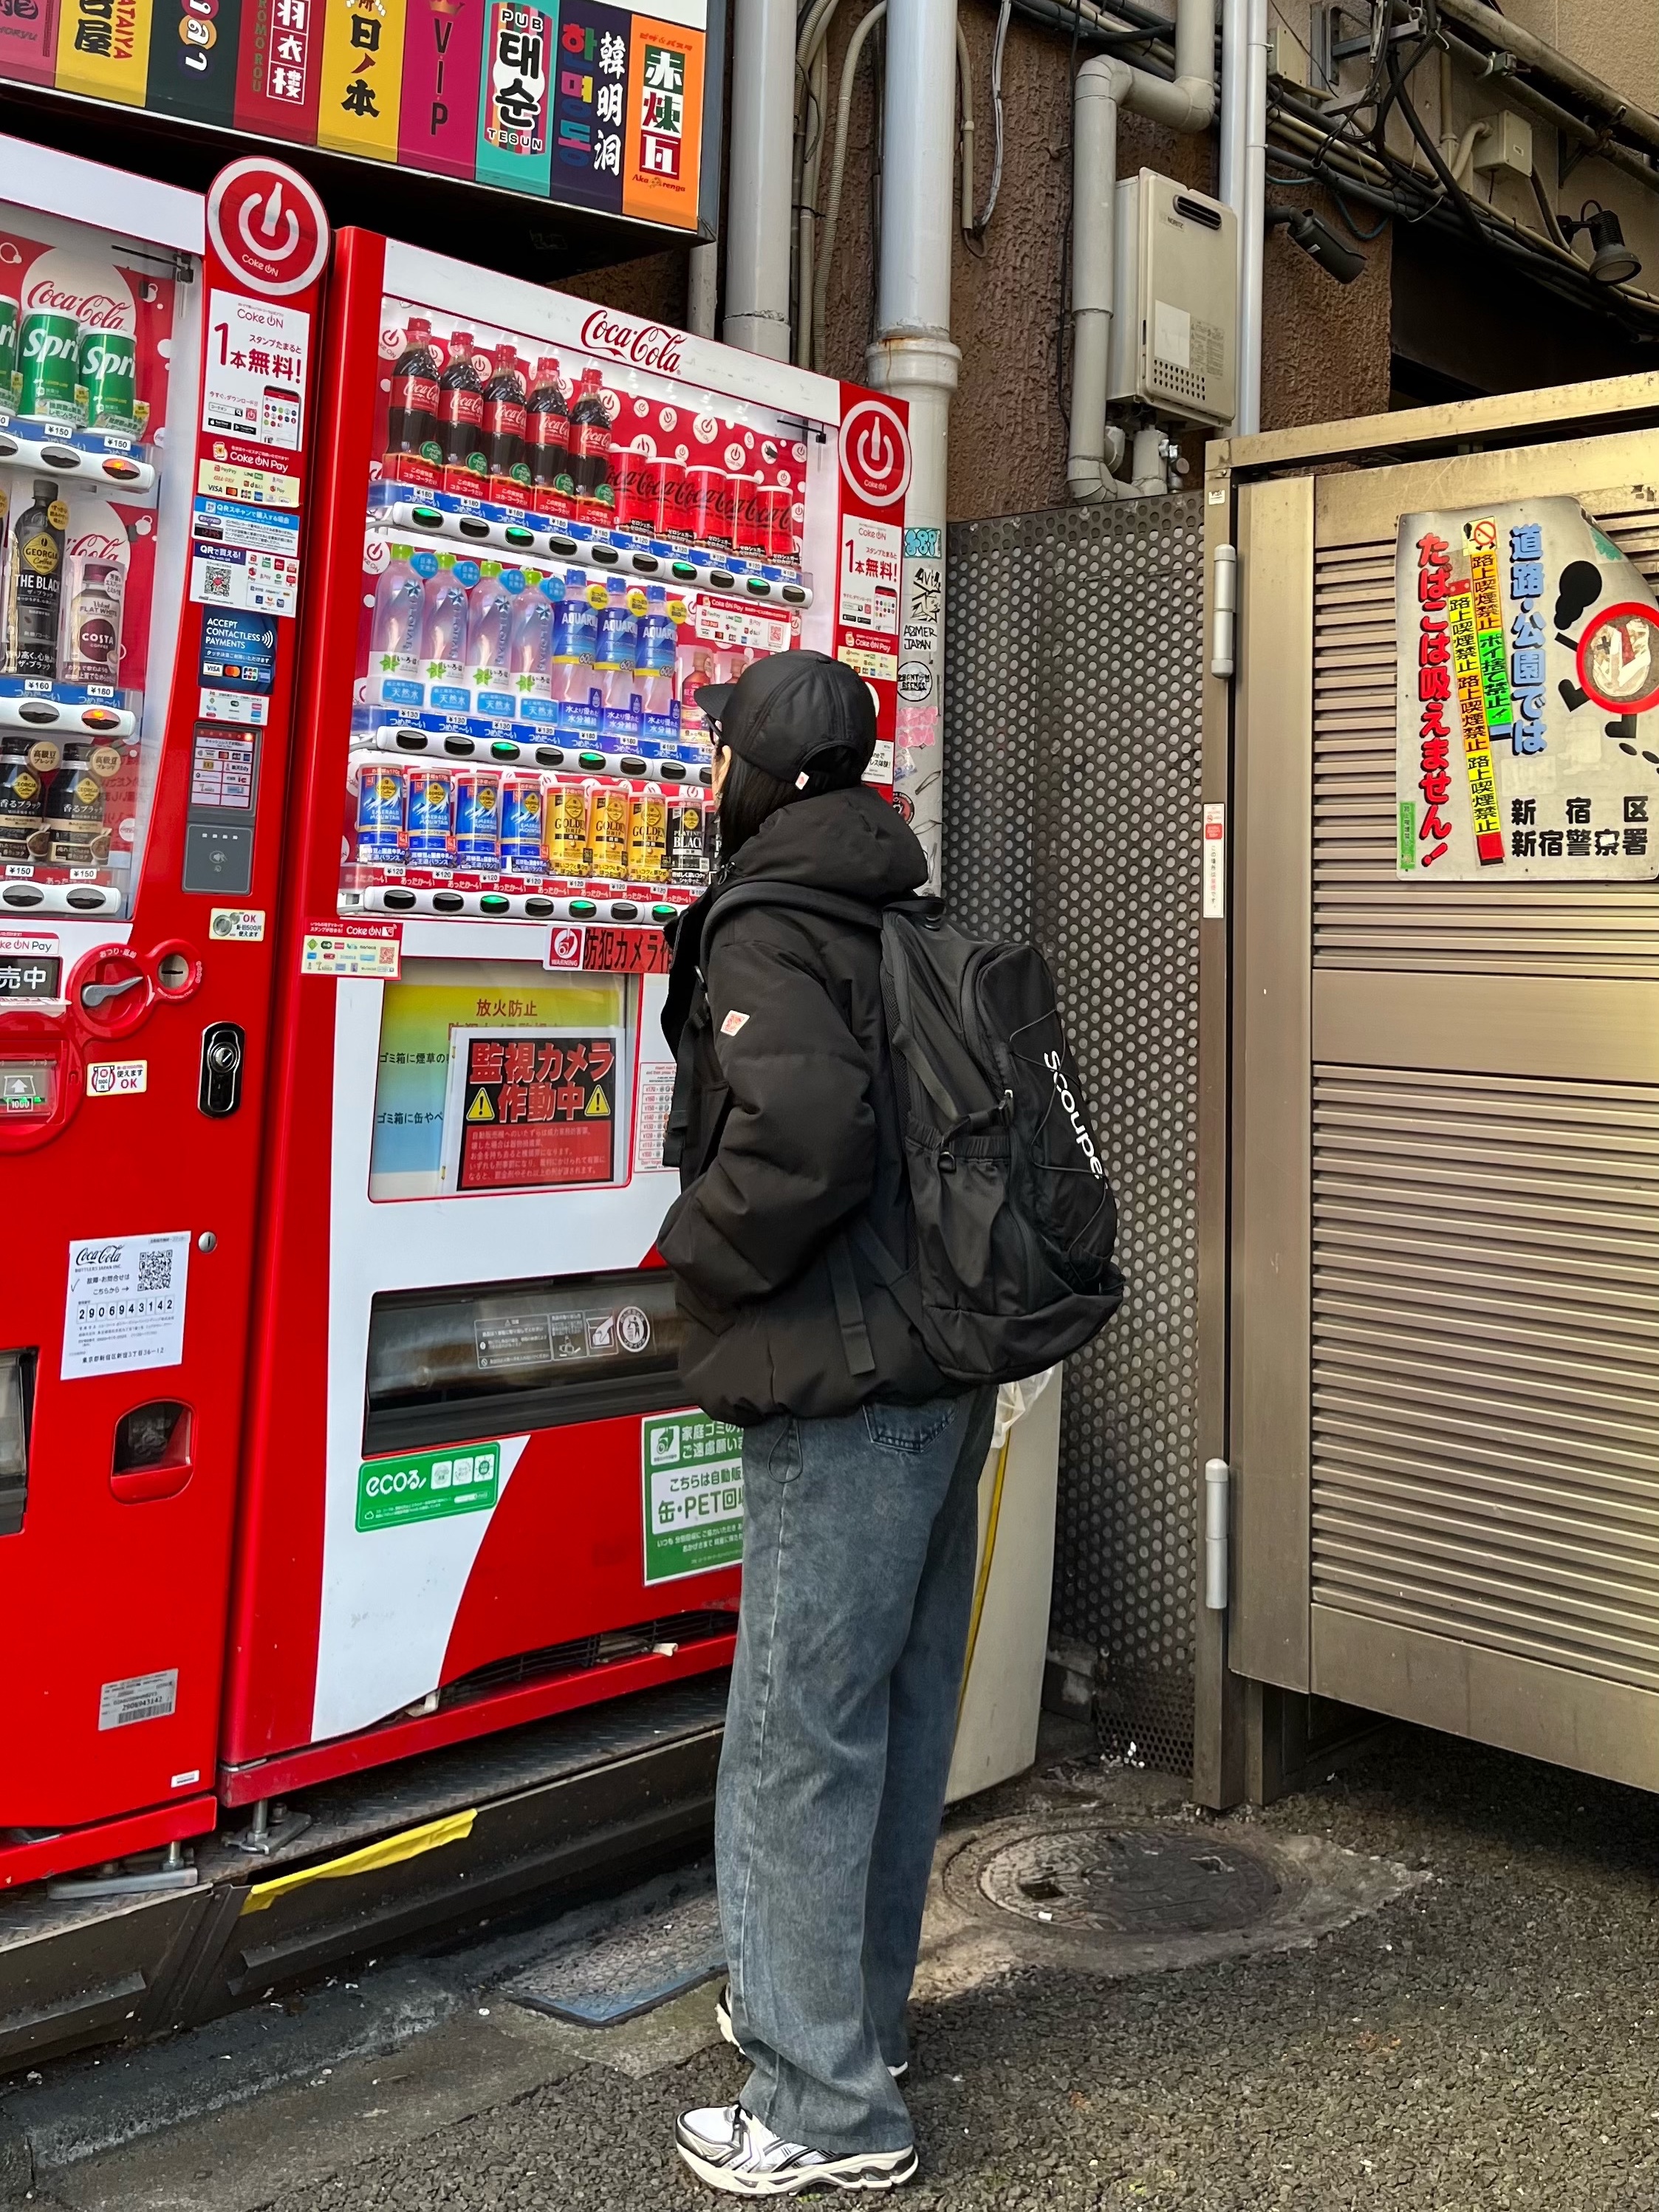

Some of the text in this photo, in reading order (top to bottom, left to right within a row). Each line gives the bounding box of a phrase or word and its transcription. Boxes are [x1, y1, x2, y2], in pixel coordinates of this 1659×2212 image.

[501, 9, 544, 30] PUB
[341, 13, 382, 117] 日ノ本
[429, 17, 453, 136] VIP
[494, 31, 541, 130] 태순
[558, 24, 598, 168] 한명동
[593, 31, 626, 177] 韓明洞
[488, 128, 543, 151] TESUN
[632, 174, 686, 192] Aka renga
[1167, 216, 1184, 230] NORITZ
[242, 253, 279, 277] Coke ON
[237, 309, 265, 323] Coke
[267, 315, 284, 329] ON
[249, 334, 302, 355] スタンプたまると
[581, 309, 688, 374] Coca-Cola
[214, 322, 302, 384] 1本無料!
[48, 425, 69, 436] ¥150
[107, 439, 128, 448] ¥150
[230, 451, 254, 465] Coke
[255, 456, 270, 468] ON
[270, 460, 289, 473] Pay
[208, 484, 223, 493] VISA
[863, 479, 888, 491] Coke ON
[858, 527, 887, 541] Coke ON
[24, 547, 59, 561] GEORGIA
[845, 539, 897, 583] 1本無料!
[15, 573, 33, 589] THE
[1471, 552, 1502, 631] 路上喫煙禁止
[80, 606, 98, 614] FLAT
[711, 599, 725, 608] Coke
[733, 603, 744, 612] Pay
[207, 617, 238, 629] ACCEPT
[81, 631, 114, 646] COSTA
[206, 626, 261, 642] CONTACTLESS
[1448, 594, 1480, 675] 路上喫煙禁止
[1509, 524, 1548, 756] 道路・公園では
[205, 636, 246, 649] PAYMENTS
[855, 637, 870, 648] Coke
[879, 643, 891, 654] Pay
[903, 638, 931, 650] JAPAN
[207, 665, 221, 673] VISA
[1479, 633, 1511, 720] ポイ捨て禁止!
[28, 682, 49, 690] ¥160
[391, 686, 420, 699] 天然水
[439, 694, 466, 705] 天然水
[485, 699, 511, 712] 天然水
[1415, 531, 1453, 869] たばこは吸えません!
[401, 710, 418, 719] ¥130
[528, 705, 554, 717] 天然水
[1457, 674, 1491, 753] 路上喫煙禁止
[448, 716, 465, 725] ¥130
[494, 722, 510, 730] ¥130
[538, 727, 553, 735] ¥130
[1466, 755, 1500, 834] 路上喫煙禁止
[1511, 796, 1649, 825] 新宿区
[9, 866, 31, 875] ¥150
[74, 869, 95, 877] ¥150
[243, 914, 256, 923] OK
[346, 925, 382, 936] Coke ON
[14, 936, 30, 951] ON
[32, 941, 52, 953] Pay
[583, 928, 673, 973] 防犯カメラ
[476, 999, 538, 1018] 放火防止
[379, 1052, 449, 1064] ゴミ箱に煙草の
[470, 1042, 615, 1084] 監視カメラ
[117, 1069, 143, 1078] 使えます
[120, 1078, 137, 1089] OK
[497, 1081, 585, 1123] 作動中
[75, 1244, 124, 1266] Coca-Cola
[86, 1273, 130, 1285] 故障・お問合せは
[93, 1287, 120, 1295] こちらから
